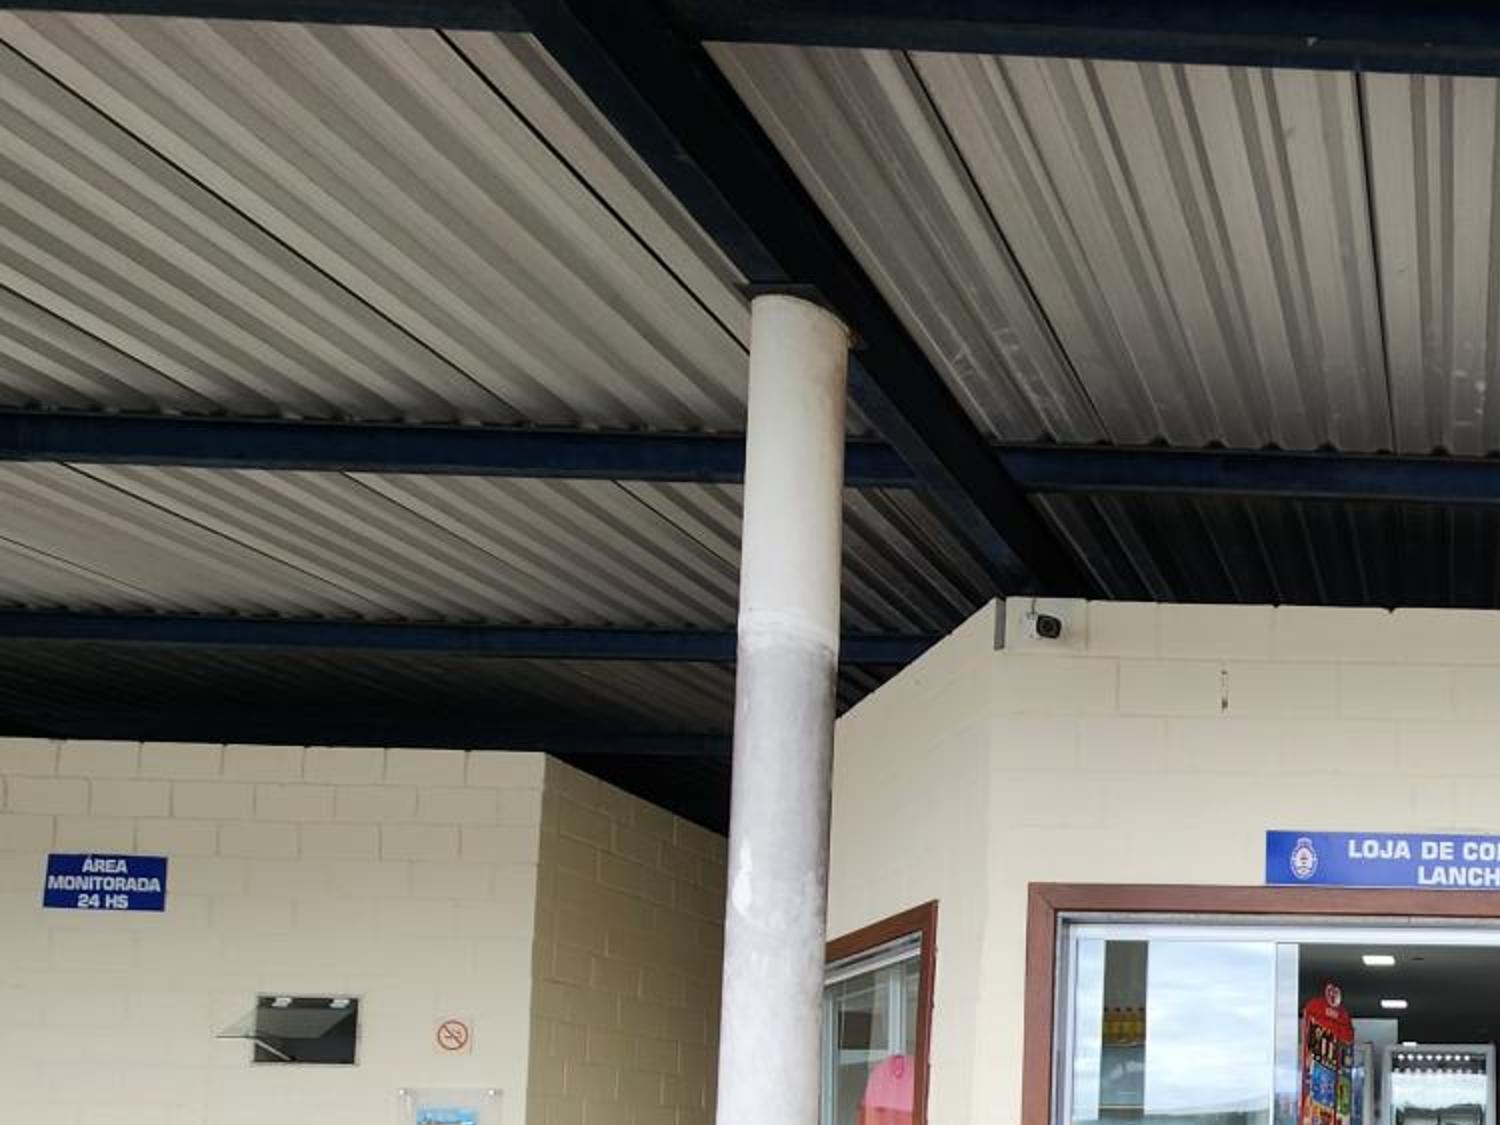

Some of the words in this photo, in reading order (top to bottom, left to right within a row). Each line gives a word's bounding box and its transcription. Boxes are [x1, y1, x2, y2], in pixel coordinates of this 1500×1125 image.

[1347, 838, 1411, 860] LOJA
[1421, 841, 1455, 861] DE
[82, 855, 128, 873] ÁREA
[47, 875, 161, 892] MONITORADA
[77, 893, 100, 908] 24
[105, 894, 129, 909] HS
